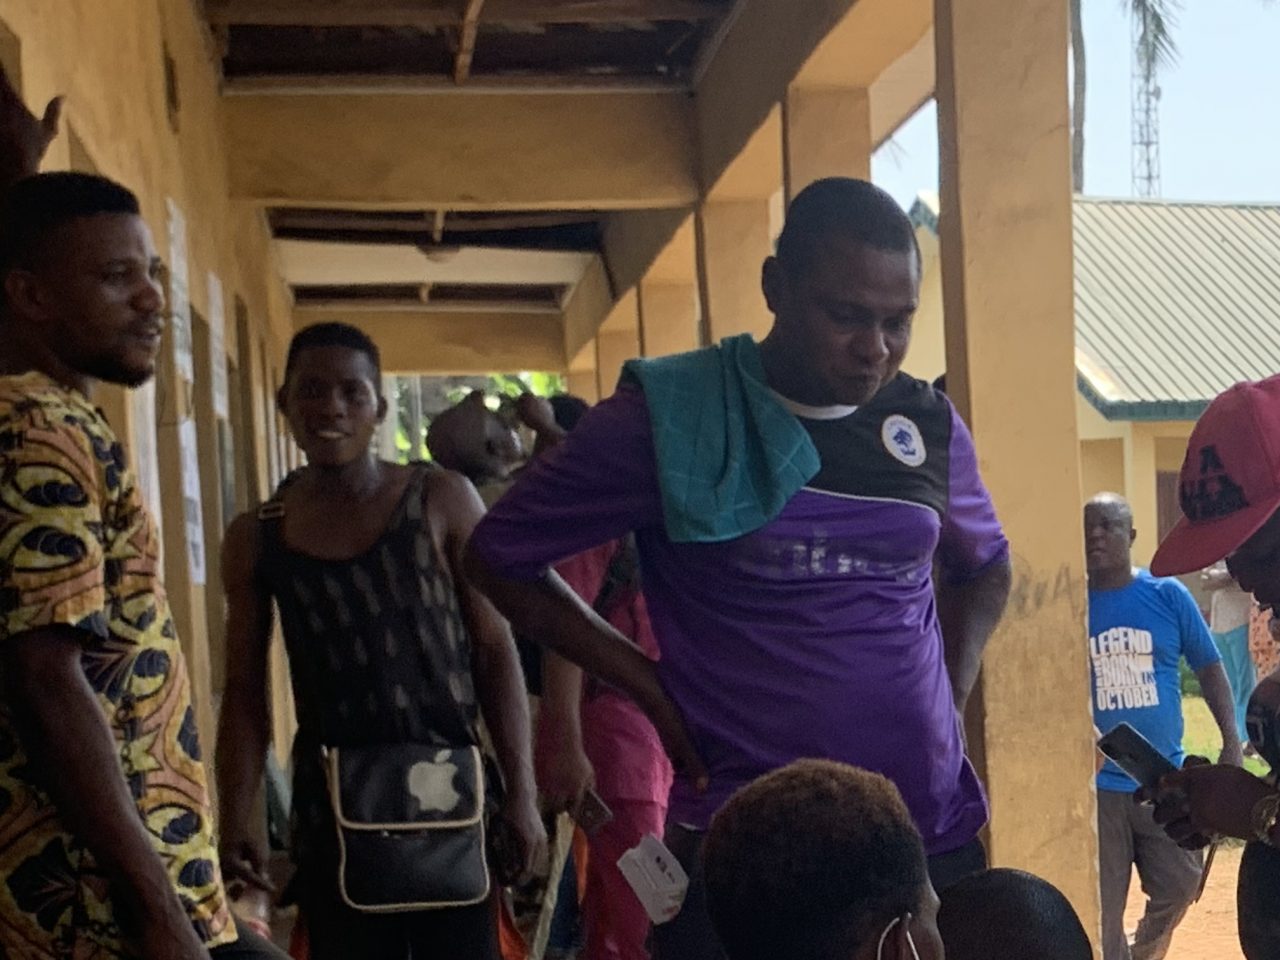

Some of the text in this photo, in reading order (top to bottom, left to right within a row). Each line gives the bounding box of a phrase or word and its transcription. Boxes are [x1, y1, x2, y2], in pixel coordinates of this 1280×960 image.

[1090, 626, 1153, 658] LEGEND
[1101, 654, 1138, 687] BORN
[1096, 684, 1160, 711] OCTOBER
